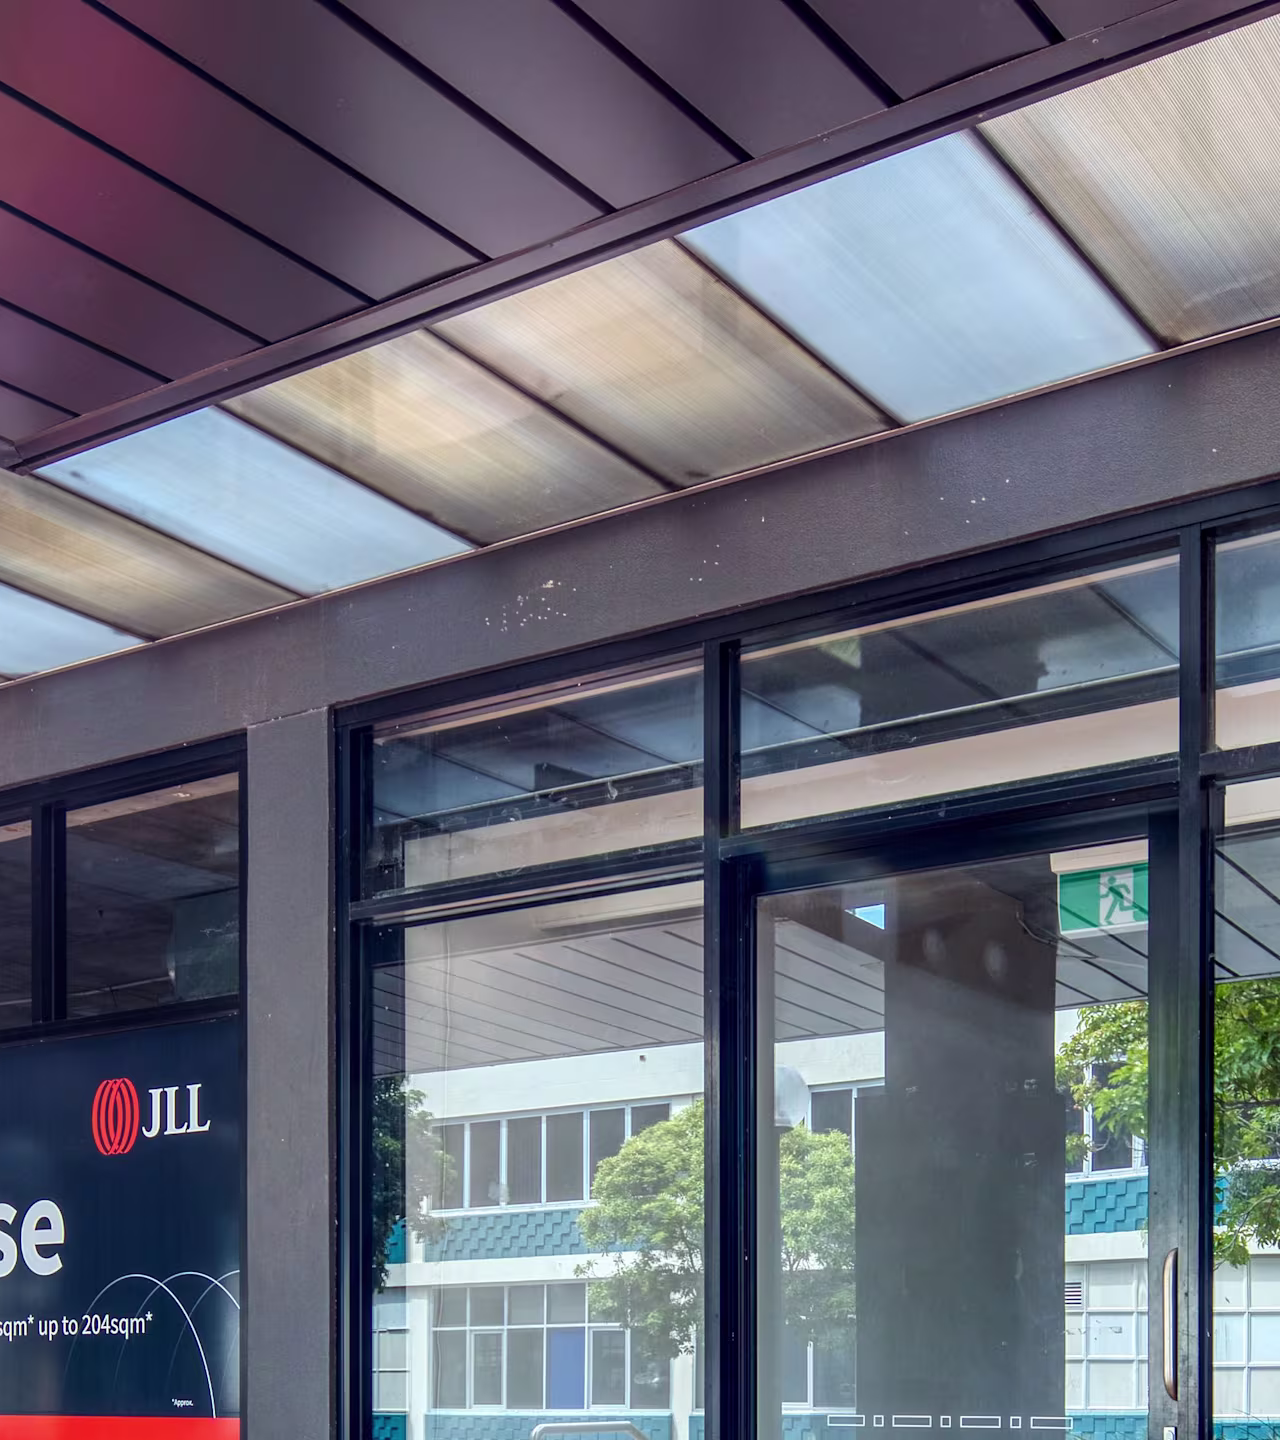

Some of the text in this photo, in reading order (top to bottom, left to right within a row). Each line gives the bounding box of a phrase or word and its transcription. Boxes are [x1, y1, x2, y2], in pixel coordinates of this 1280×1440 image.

[142, 1083, 211, 1138] JLL
[38, 1322, 59, 1341] up
[62, 1316, 78, 1335] to
